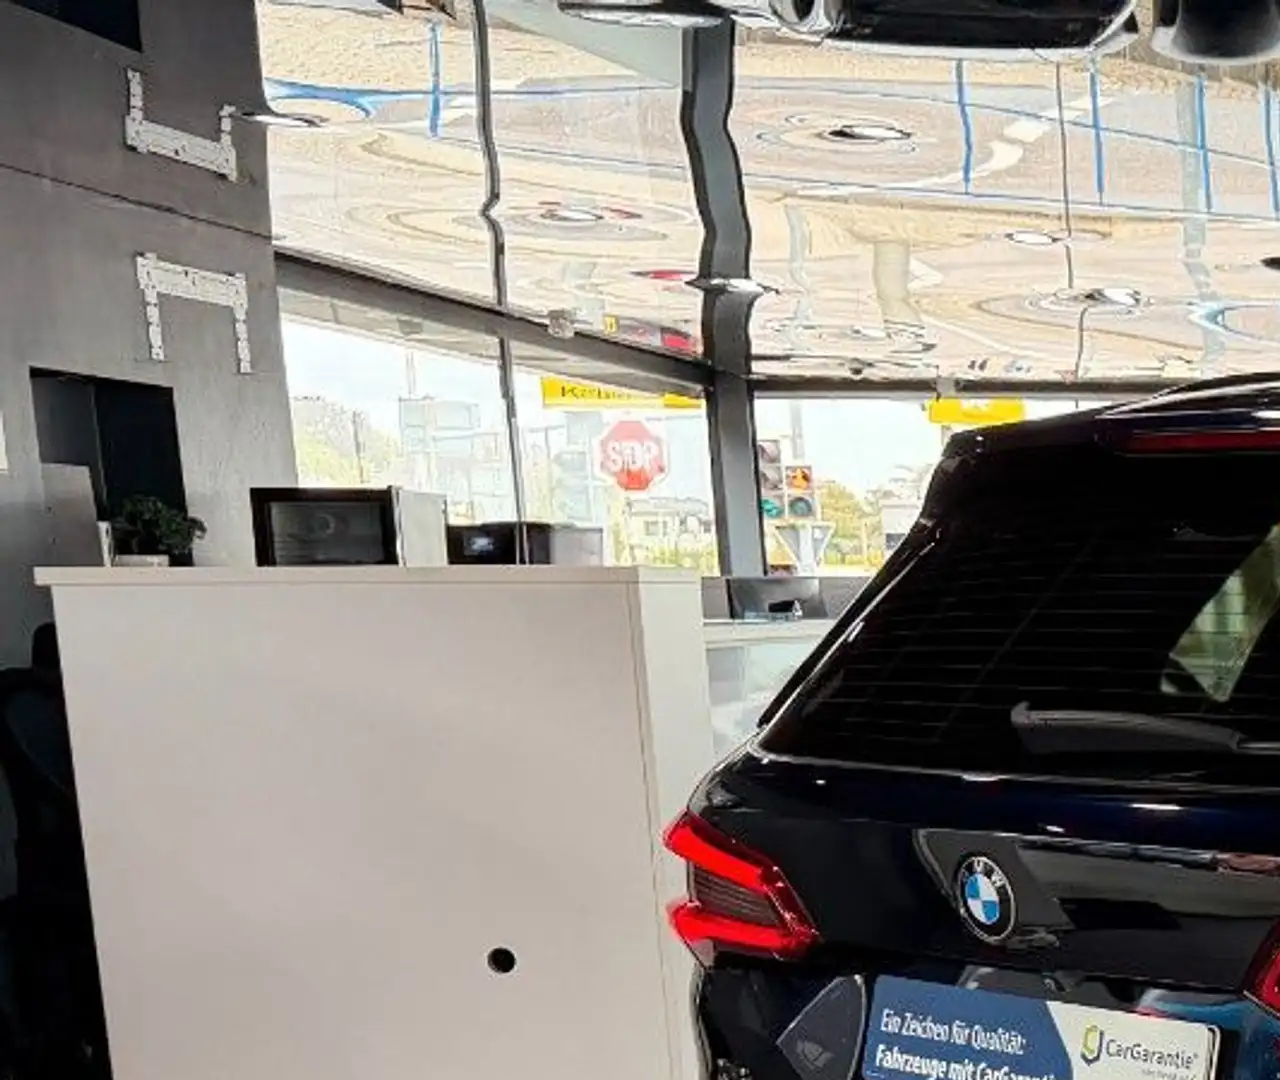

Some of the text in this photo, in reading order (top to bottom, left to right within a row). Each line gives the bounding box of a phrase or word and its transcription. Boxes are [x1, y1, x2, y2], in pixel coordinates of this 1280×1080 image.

[606, 438, 661, 471] STOP
[879, 1008, 902, 1033] Ein
[902, 1012, 950, 1042] Zeichen
[950, 1020, 970, 1046] für
